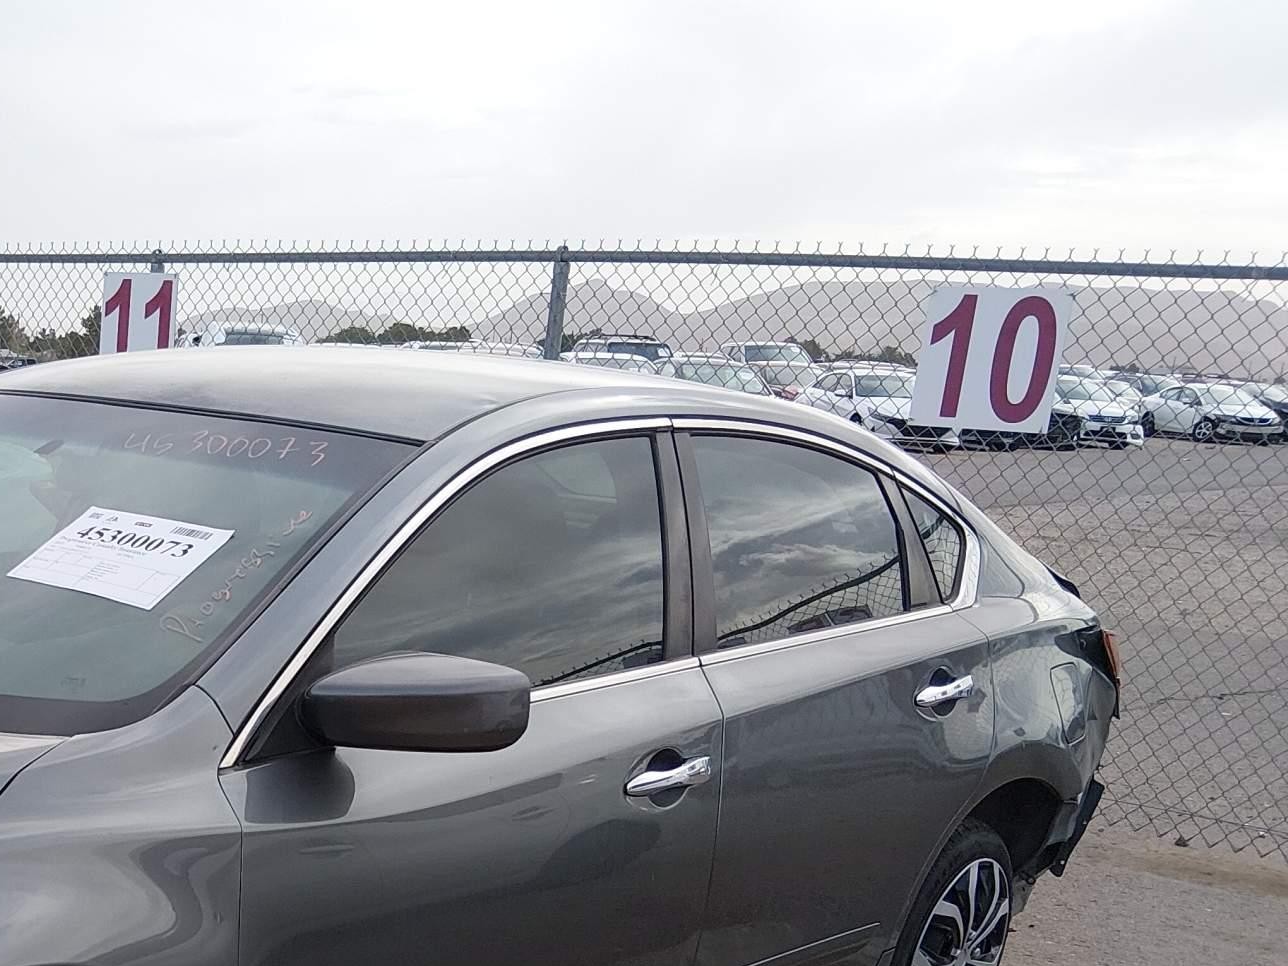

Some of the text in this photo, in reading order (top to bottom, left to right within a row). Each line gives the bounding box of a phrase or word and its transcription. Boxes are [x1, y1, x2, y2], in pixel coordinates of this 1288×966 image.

[105, 278, 173, 353] 11
[930, 294, 1057, 424] 10
[76, 525, 196, 559] 45300073
